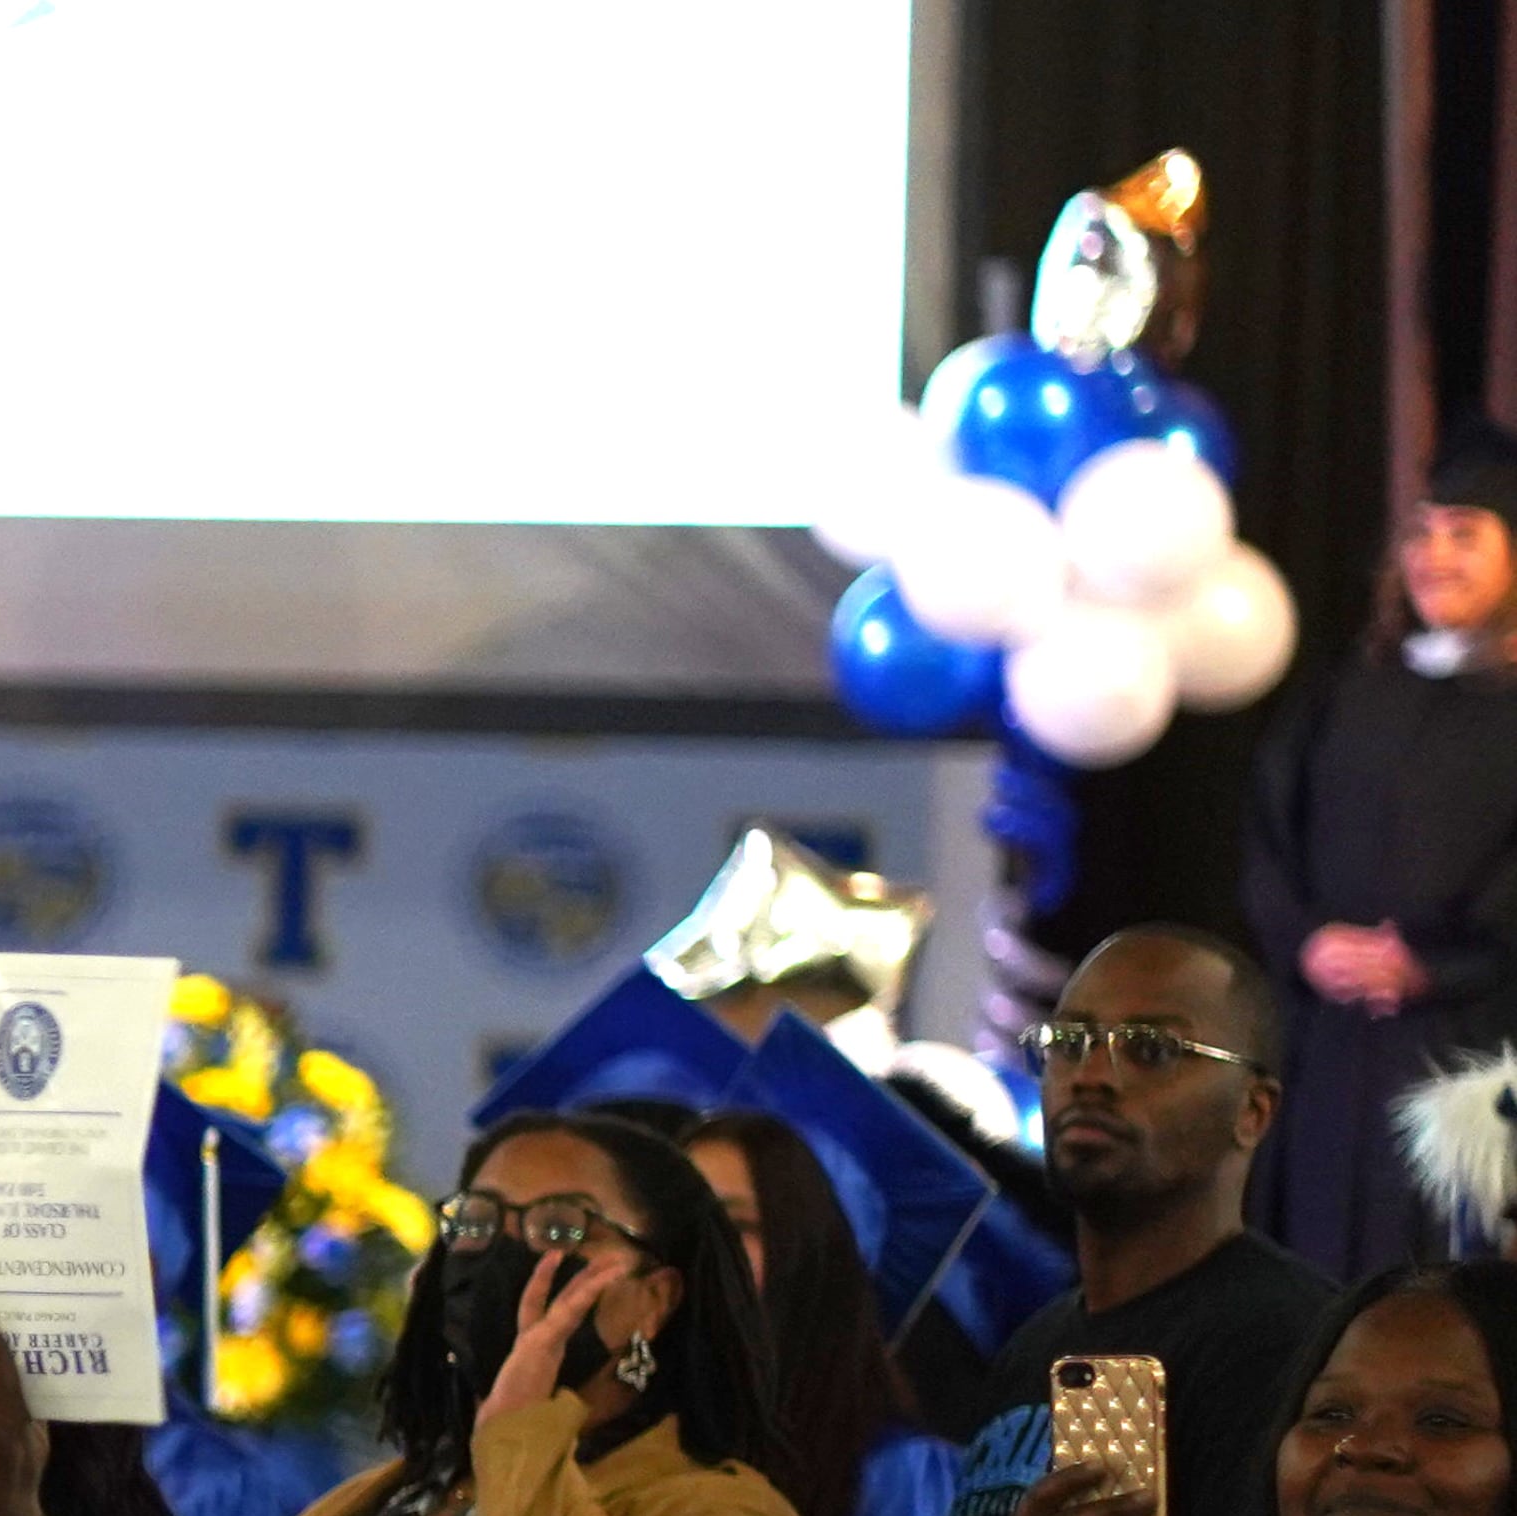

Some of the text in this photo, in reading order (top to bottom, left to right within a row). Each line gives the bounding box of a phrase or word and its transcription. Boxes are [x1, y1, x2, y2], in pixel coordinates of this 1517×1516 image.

[226, 811, 363, 969] T
[2, 1224, 21, 1239] OF
[24, 1224, 67, 1238] CLASS
[6, 1348, 111, 1376] RICH
